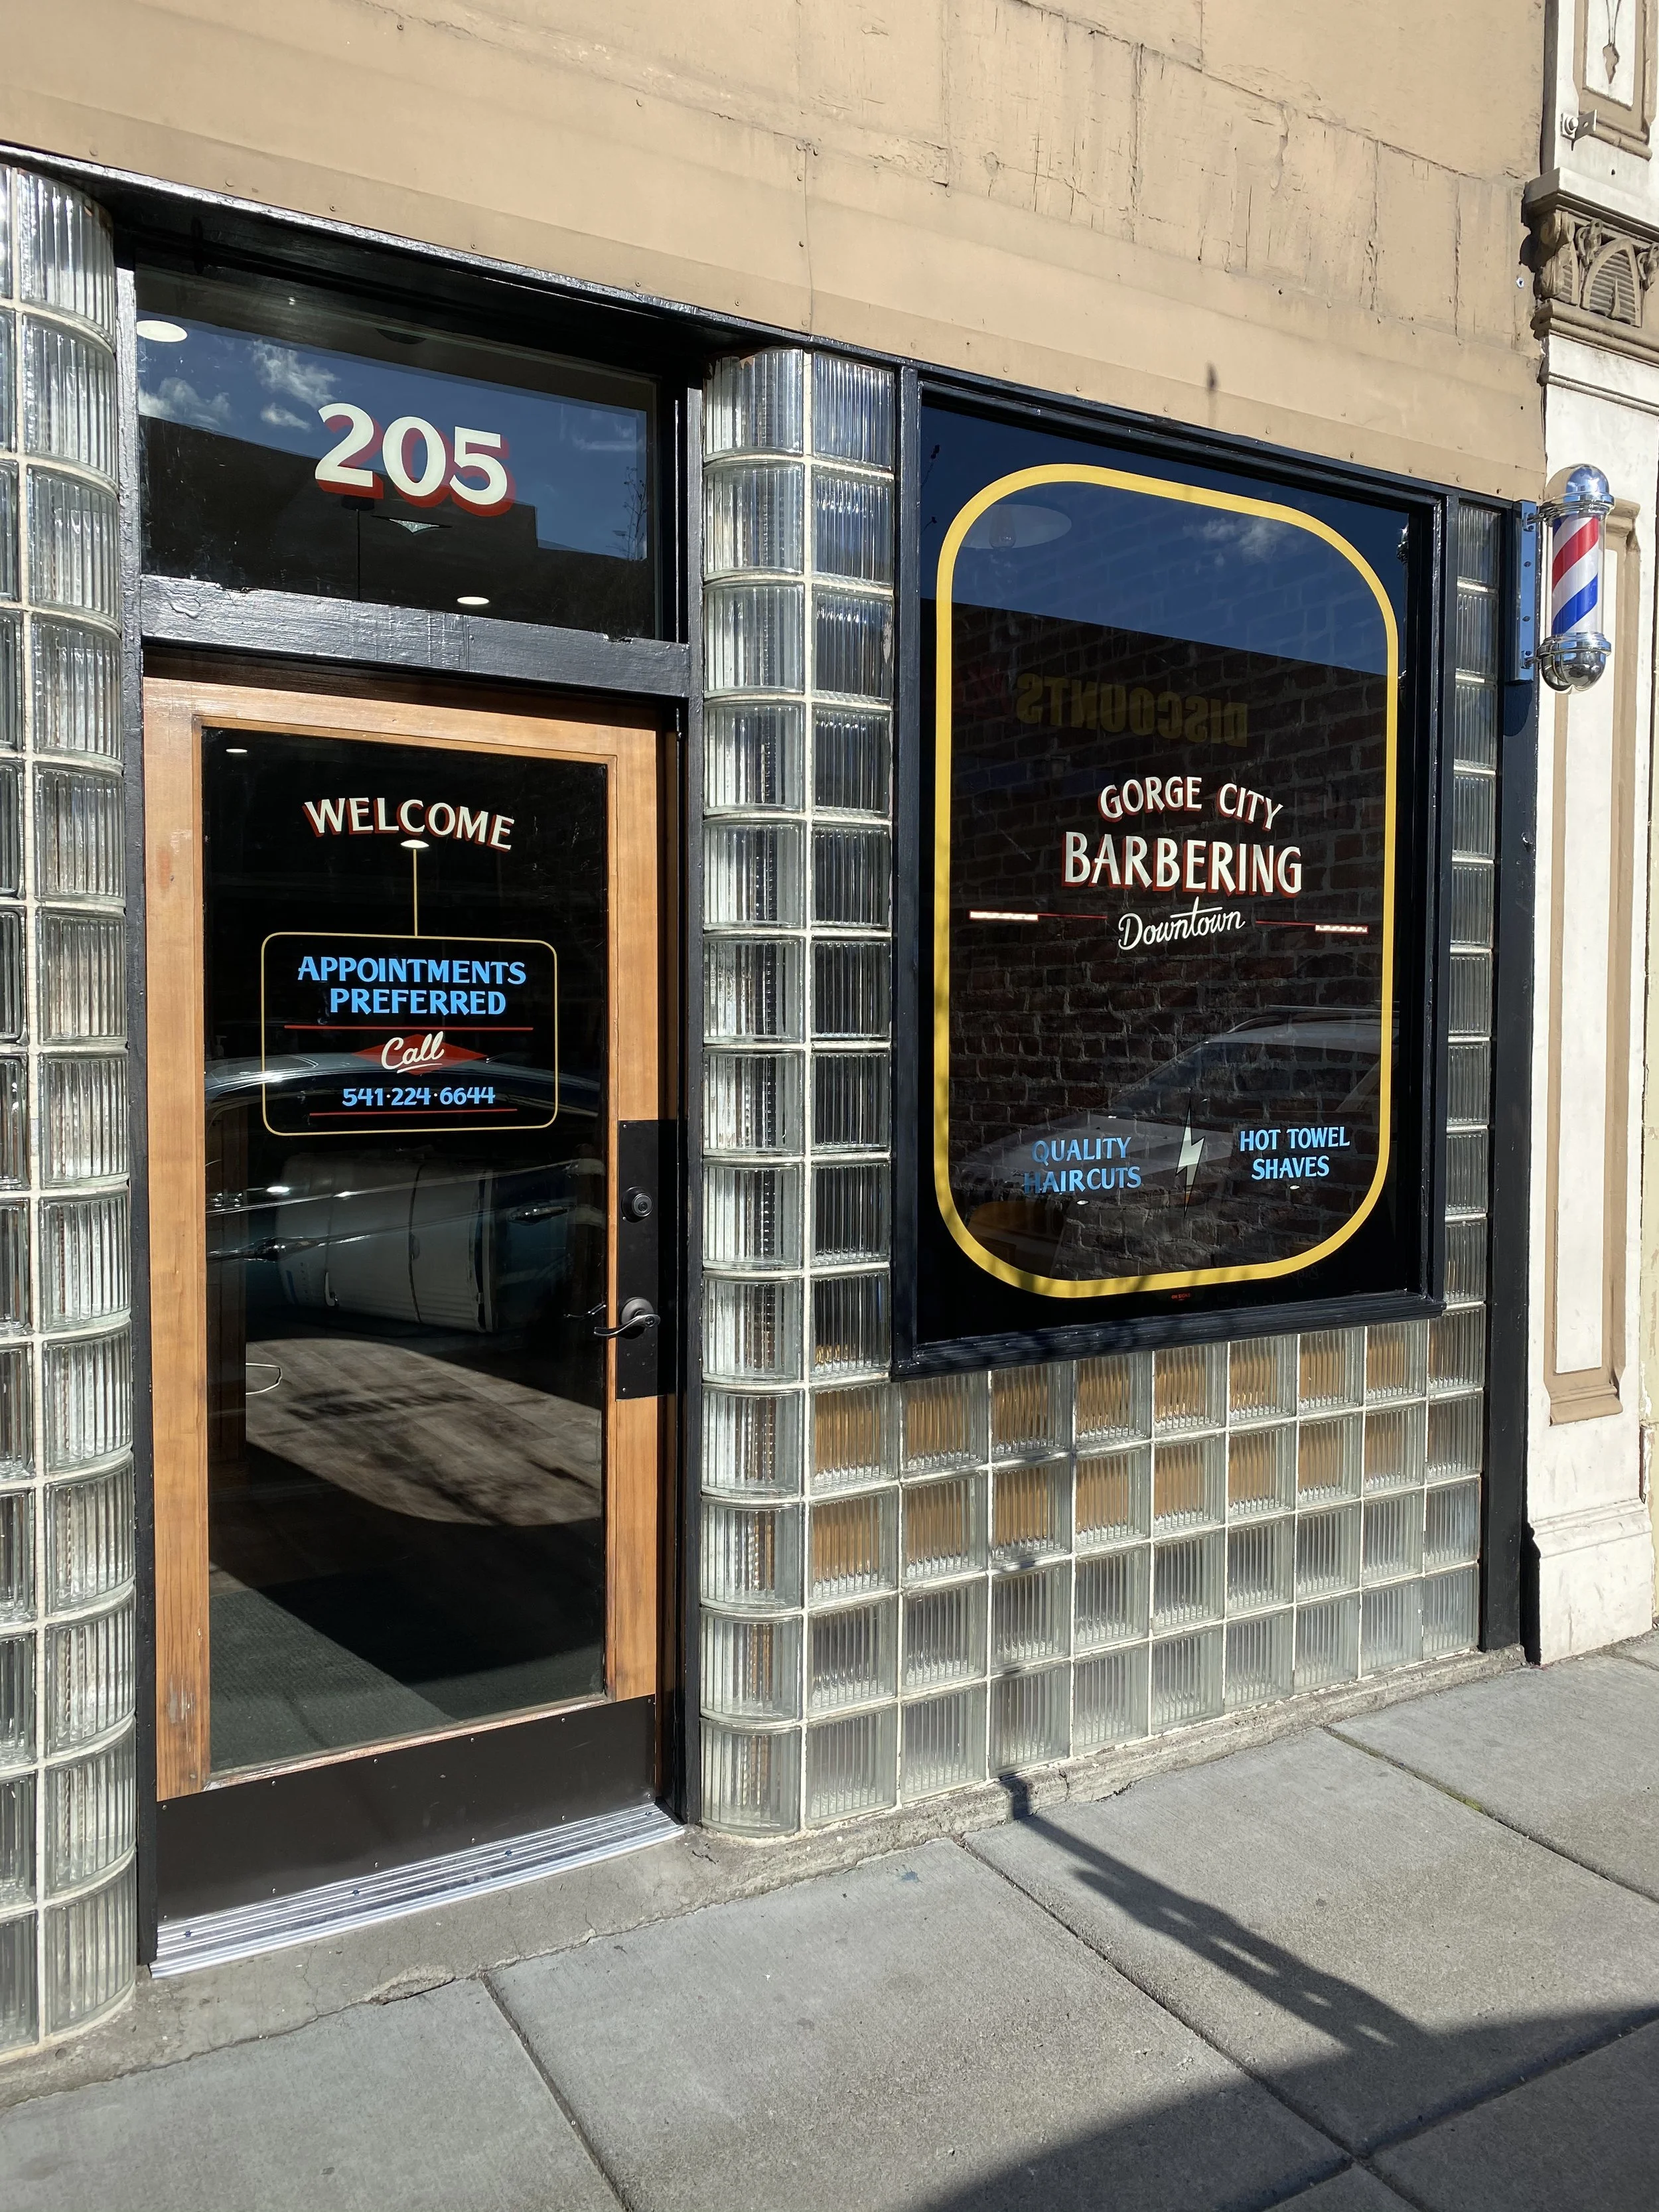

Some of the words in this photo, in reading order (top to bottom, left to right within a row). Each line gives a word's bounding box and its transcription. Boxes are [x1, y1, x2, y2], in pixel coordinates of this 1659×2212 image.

[315, 402, 516, 517] 205
[1098, 776, 1202, 823] GORGE
[1216, 782, 1283, 832] CITY
[303, 797, 515, 852] WELCOME
[1062, 831, 1302, 897] BARBERING
[1118, 897, 1246, 950] Downtown
[297, 956, 527, 985] APPOINTMENTS
[330, 988, 506, 1016] PREFERRED
[381, 1031, 445, 1070] Call
[1031, 1136, 1132, 1167] QUALITY
[1240, 1129, 1281, 1151] HOT
[1286, 1126, 1350, 1149] TOWEL
[1023, 1165, 1142, 1194] HAIRCUTS
[1251, 1155, 1330, 1181] SHAVES
